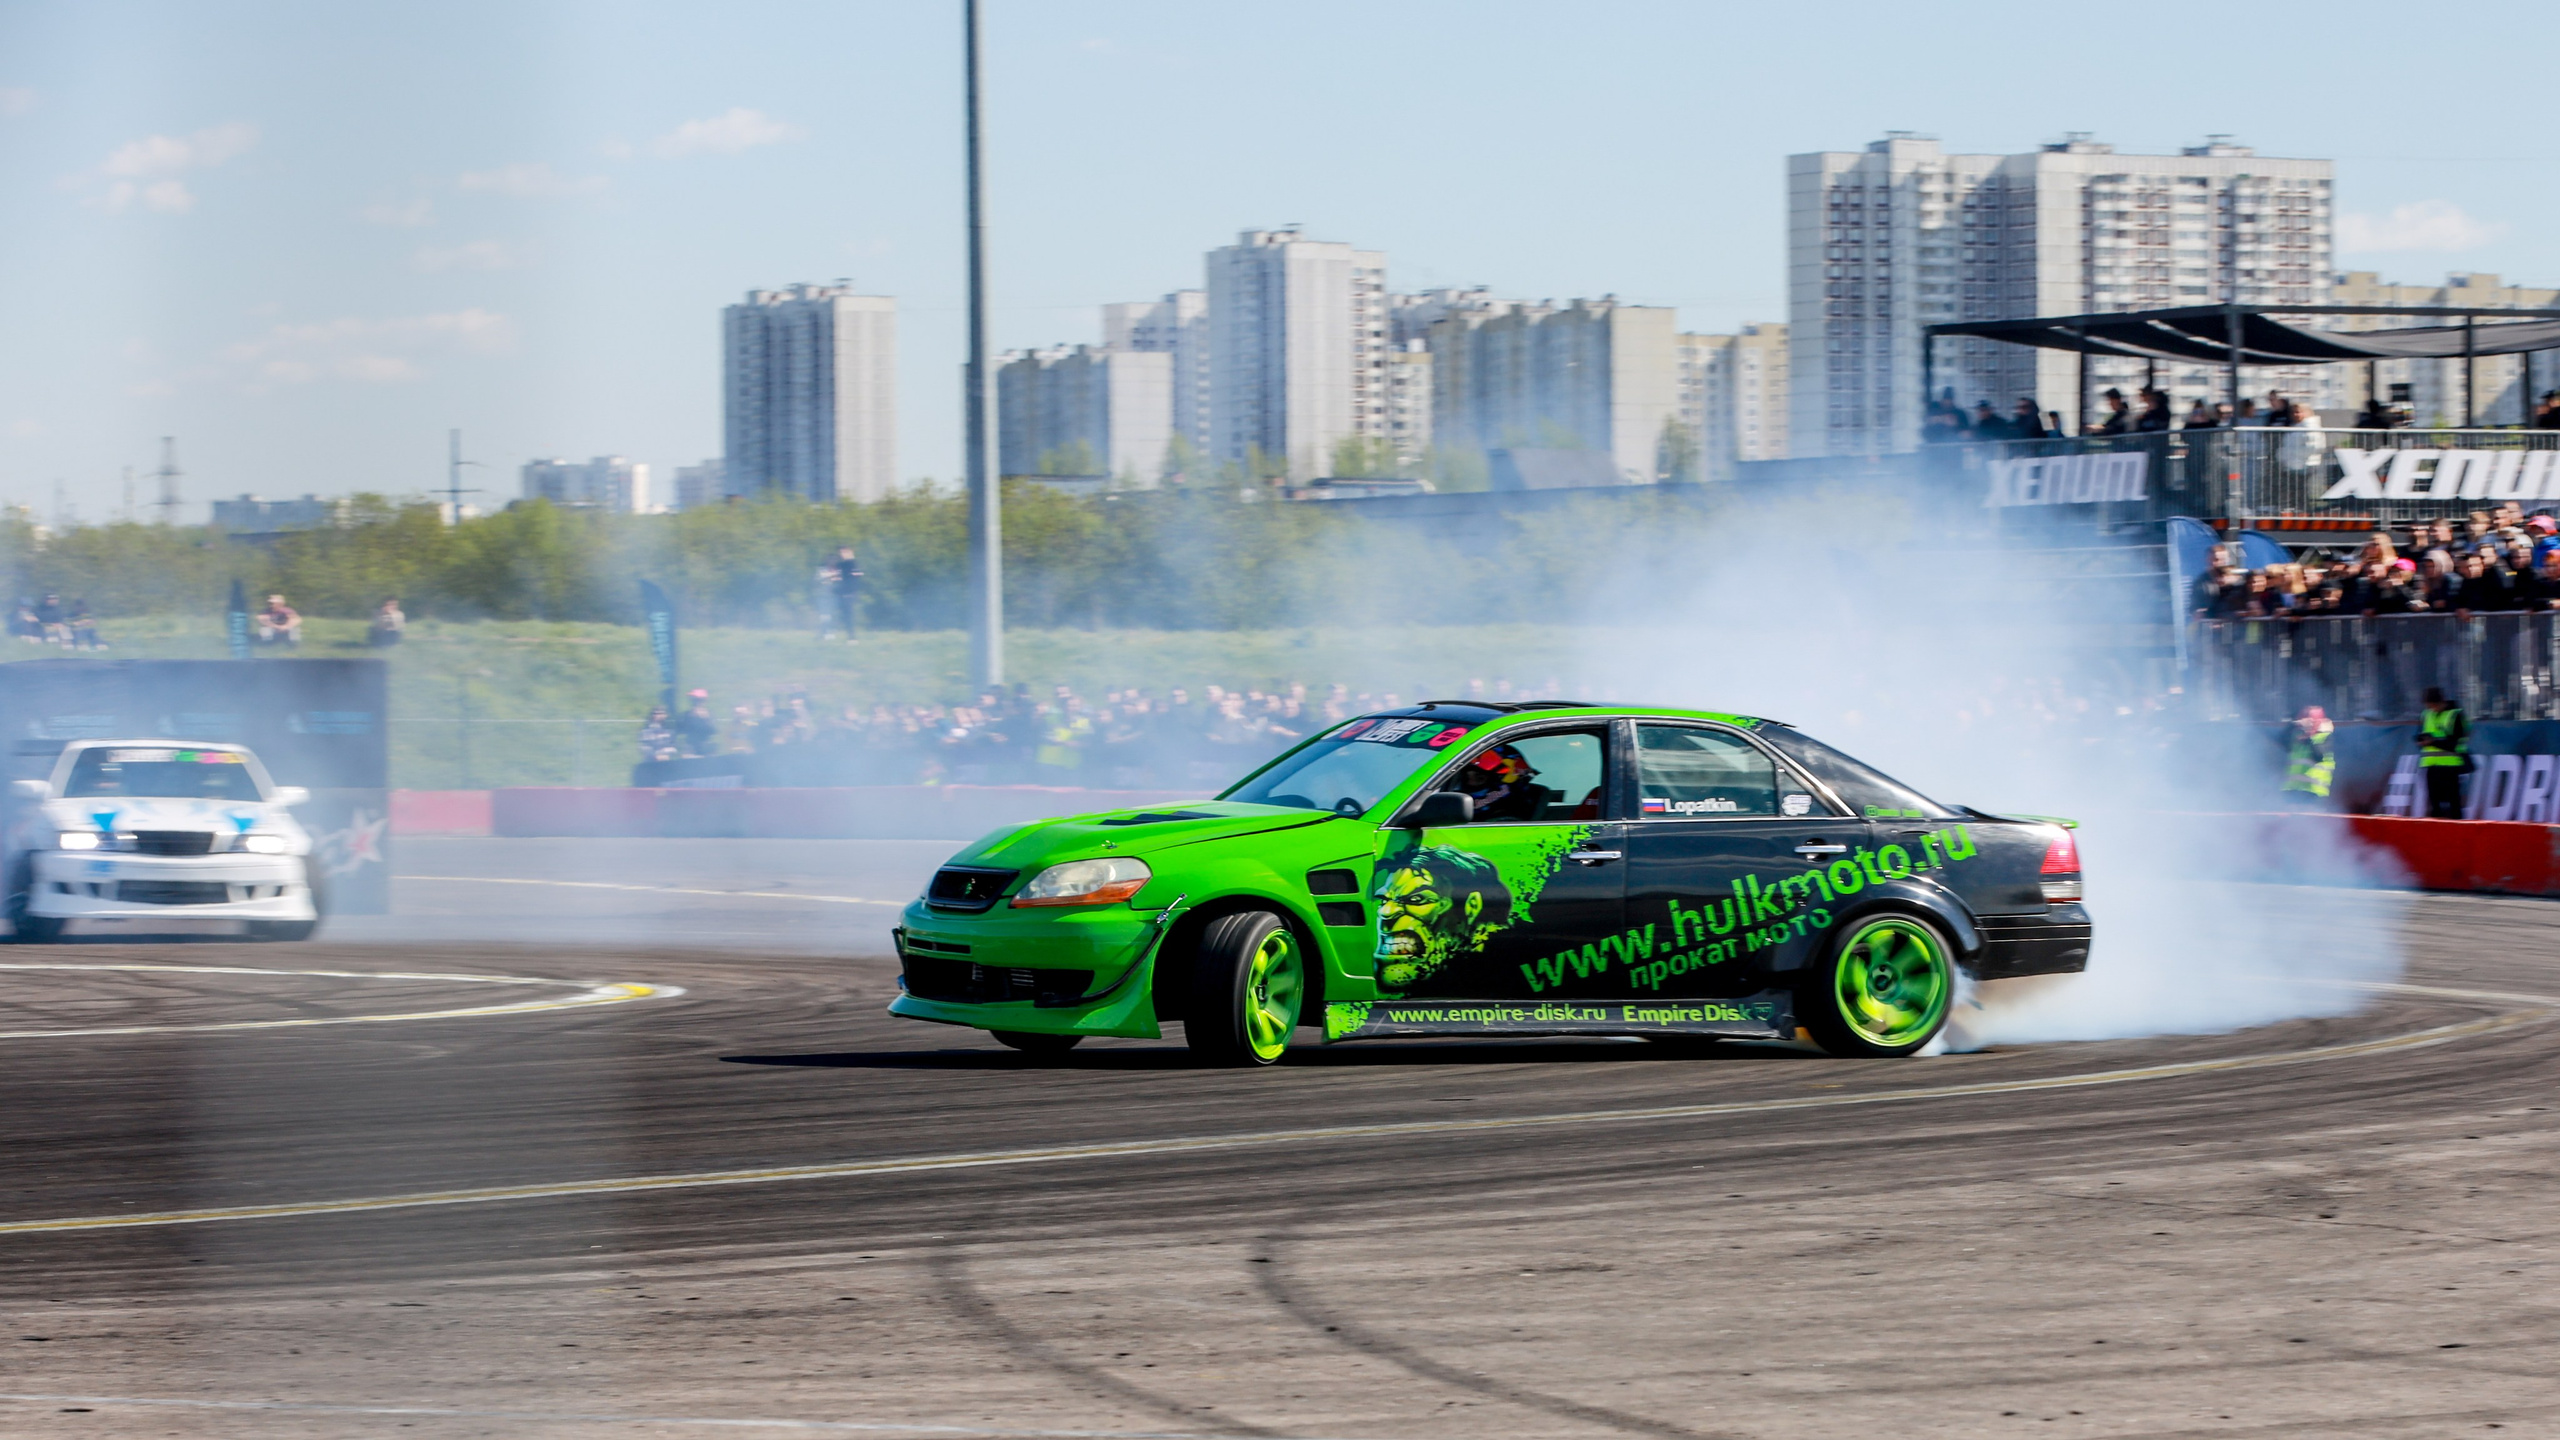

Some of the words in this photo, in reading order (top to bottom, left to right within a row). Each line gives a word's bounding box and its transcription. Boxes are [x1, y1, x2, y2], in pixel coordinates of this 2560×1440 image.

[1665, 797, 1738, 816] Lopatkin
[1519, 824, 1978, 993] www.hulkmoto.ru
[1629, 937, 1738, 991] прокат
[1389, 1003, 1607, 1025] www.empire-disk.ru
